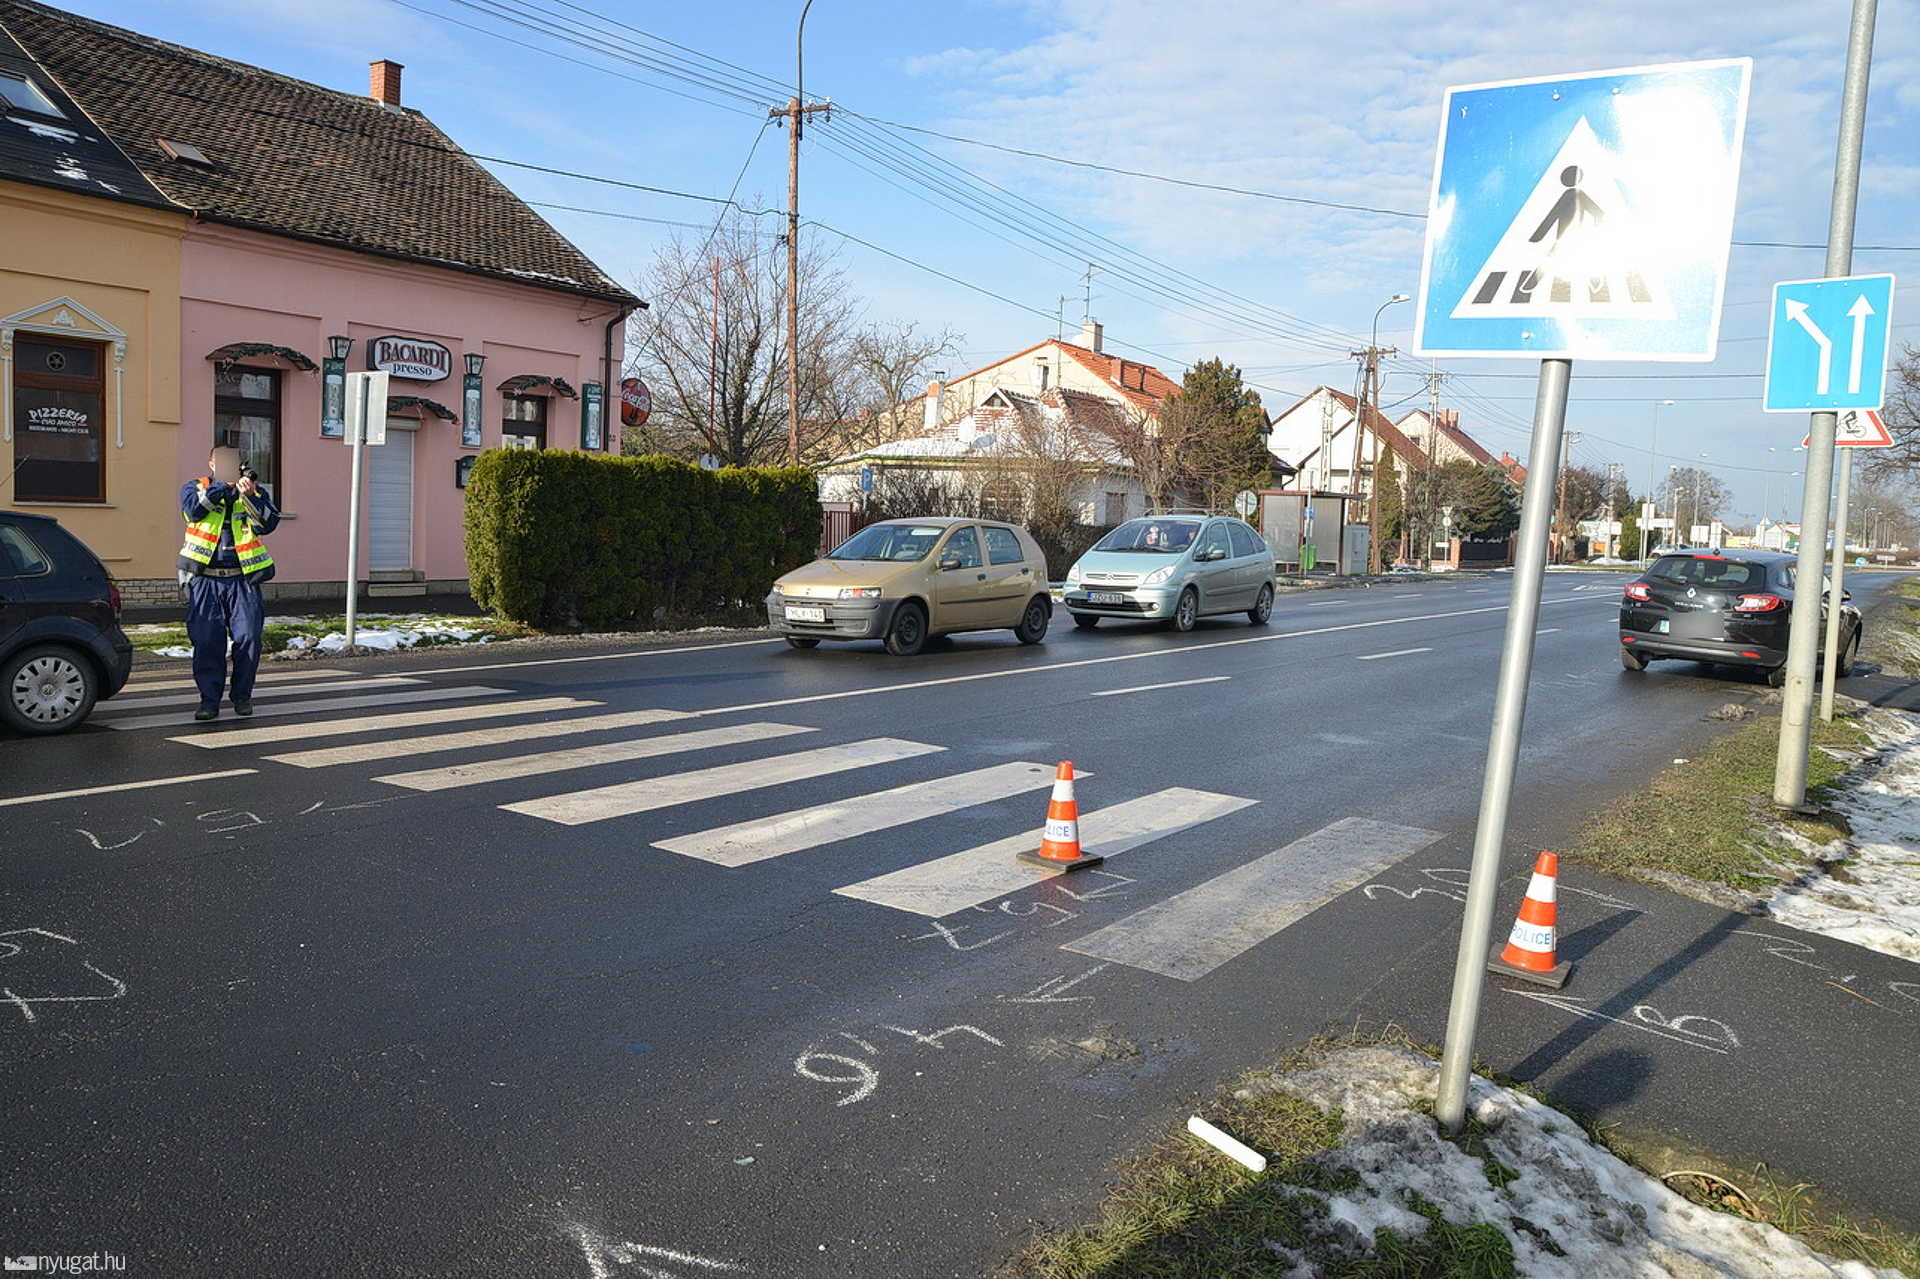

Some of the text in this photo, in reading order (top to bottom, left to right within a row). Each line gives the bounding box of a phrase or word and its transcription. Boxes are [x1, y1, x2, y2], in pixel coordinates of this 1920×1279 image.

[379, 341, 448, 373] BACARDI
[393, 362, 433, 376] presso
[28, 407, 87, 423] PIZZERIA
